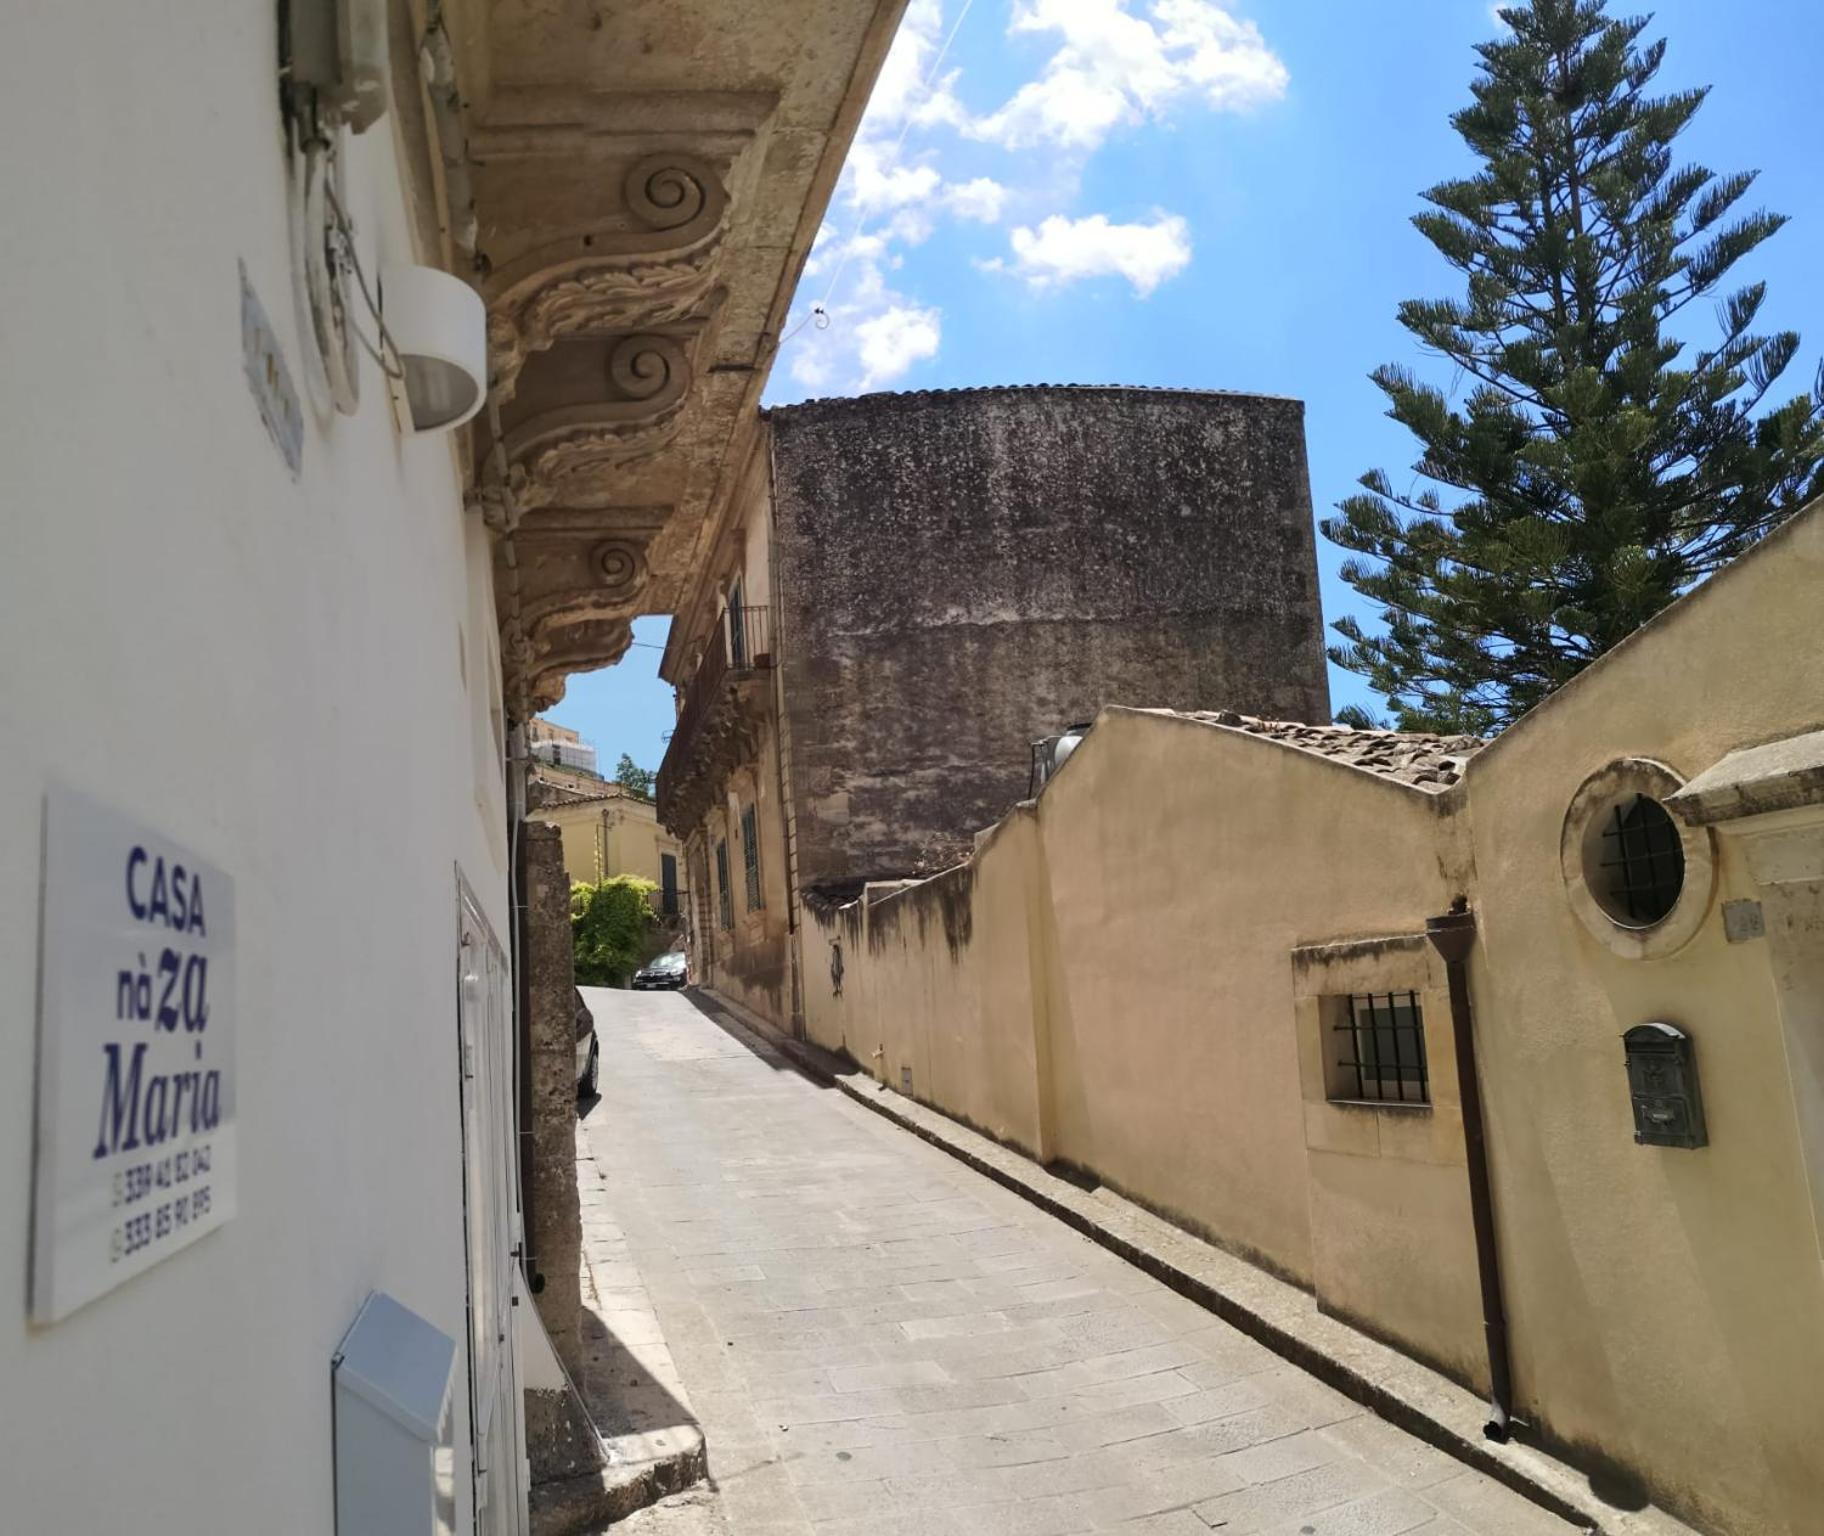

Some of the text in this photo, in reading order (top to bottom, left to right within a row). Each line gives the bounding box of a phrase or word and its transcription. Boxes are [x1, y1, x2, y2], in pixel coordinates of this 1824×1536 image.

[127, 846, 206, 937] CASA
[92, 1039, 221, 1160] Maria
[124, 1211, 151, 1256] 333
